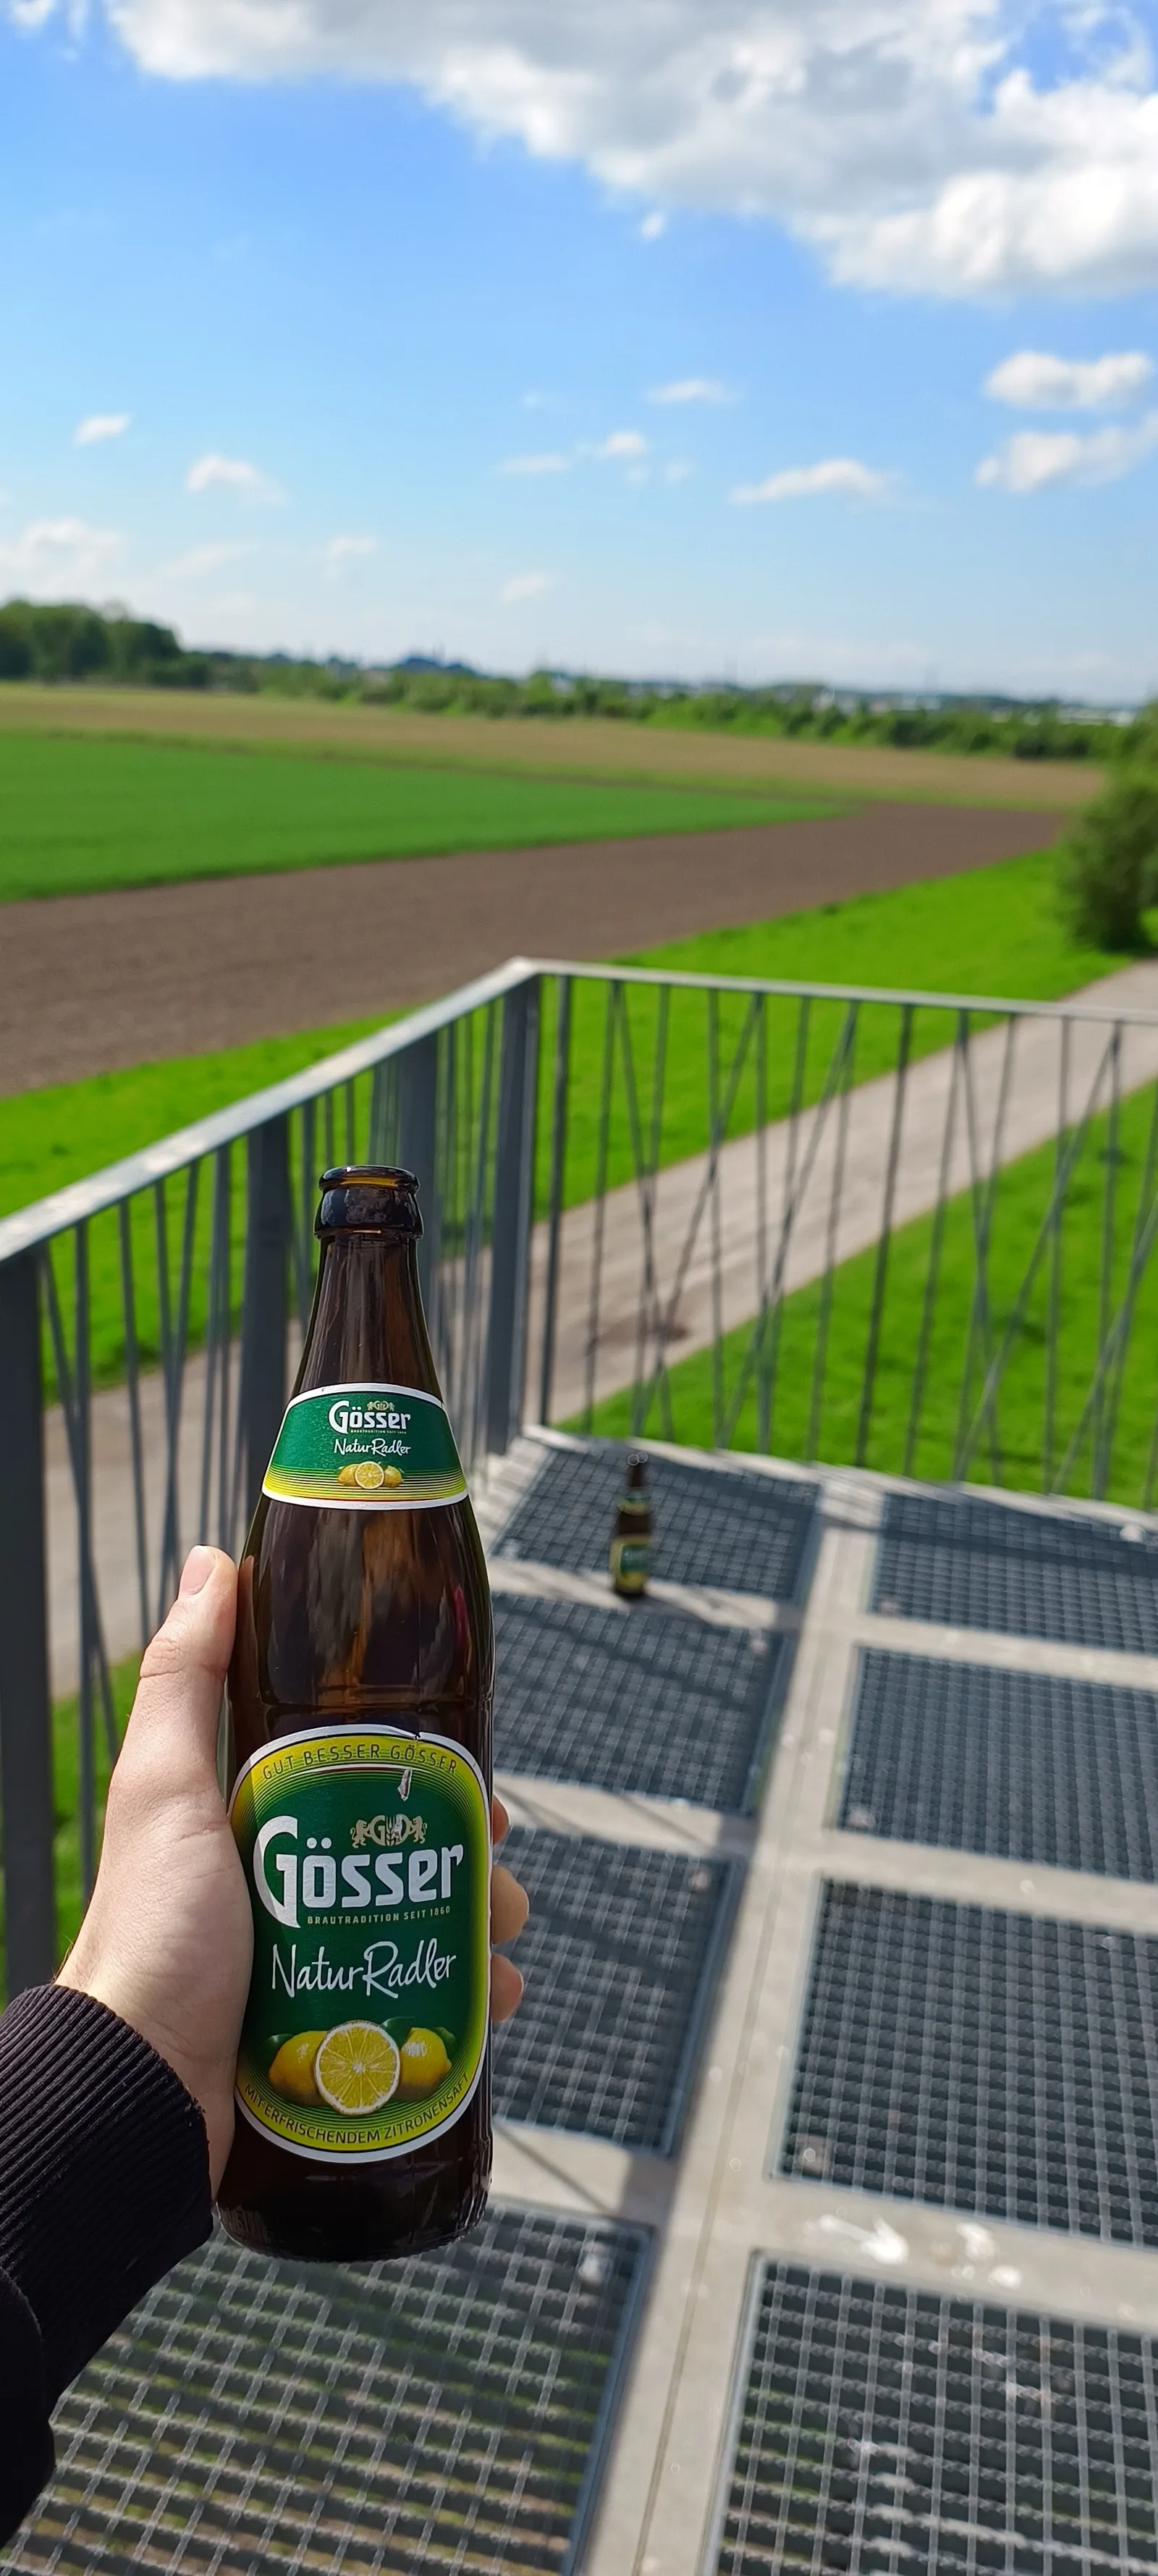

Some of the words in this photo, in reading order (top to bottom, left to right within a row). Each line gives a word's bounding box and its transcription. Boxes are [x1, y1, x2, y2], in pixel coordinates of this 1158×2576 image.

[329, 1400, 411, 1434] Gösser
[334, 1438, 411, 1457] NaturRadler
[263, 1755, 294, 1780] GUT
[304, 1744, 380, 1766] BESSER
[390, 1743, 457, 1774] GÖSSER
[253, 1815, 464, 1929] Gösser
[307, 1913, 400, 1924] BRAUTRADITION
[404, 1909, 426, 1920] SEIT
[430, 1906, 451, 1917] 1860
[271, 1938, 457, 1999] NaturRadler
[244, 2083, 265, 2108] MIT
[263, 2103, 380, 2144] ERFRISCHENDEM
[384, 2072, 470, 2140] ZITRONENSAFT
